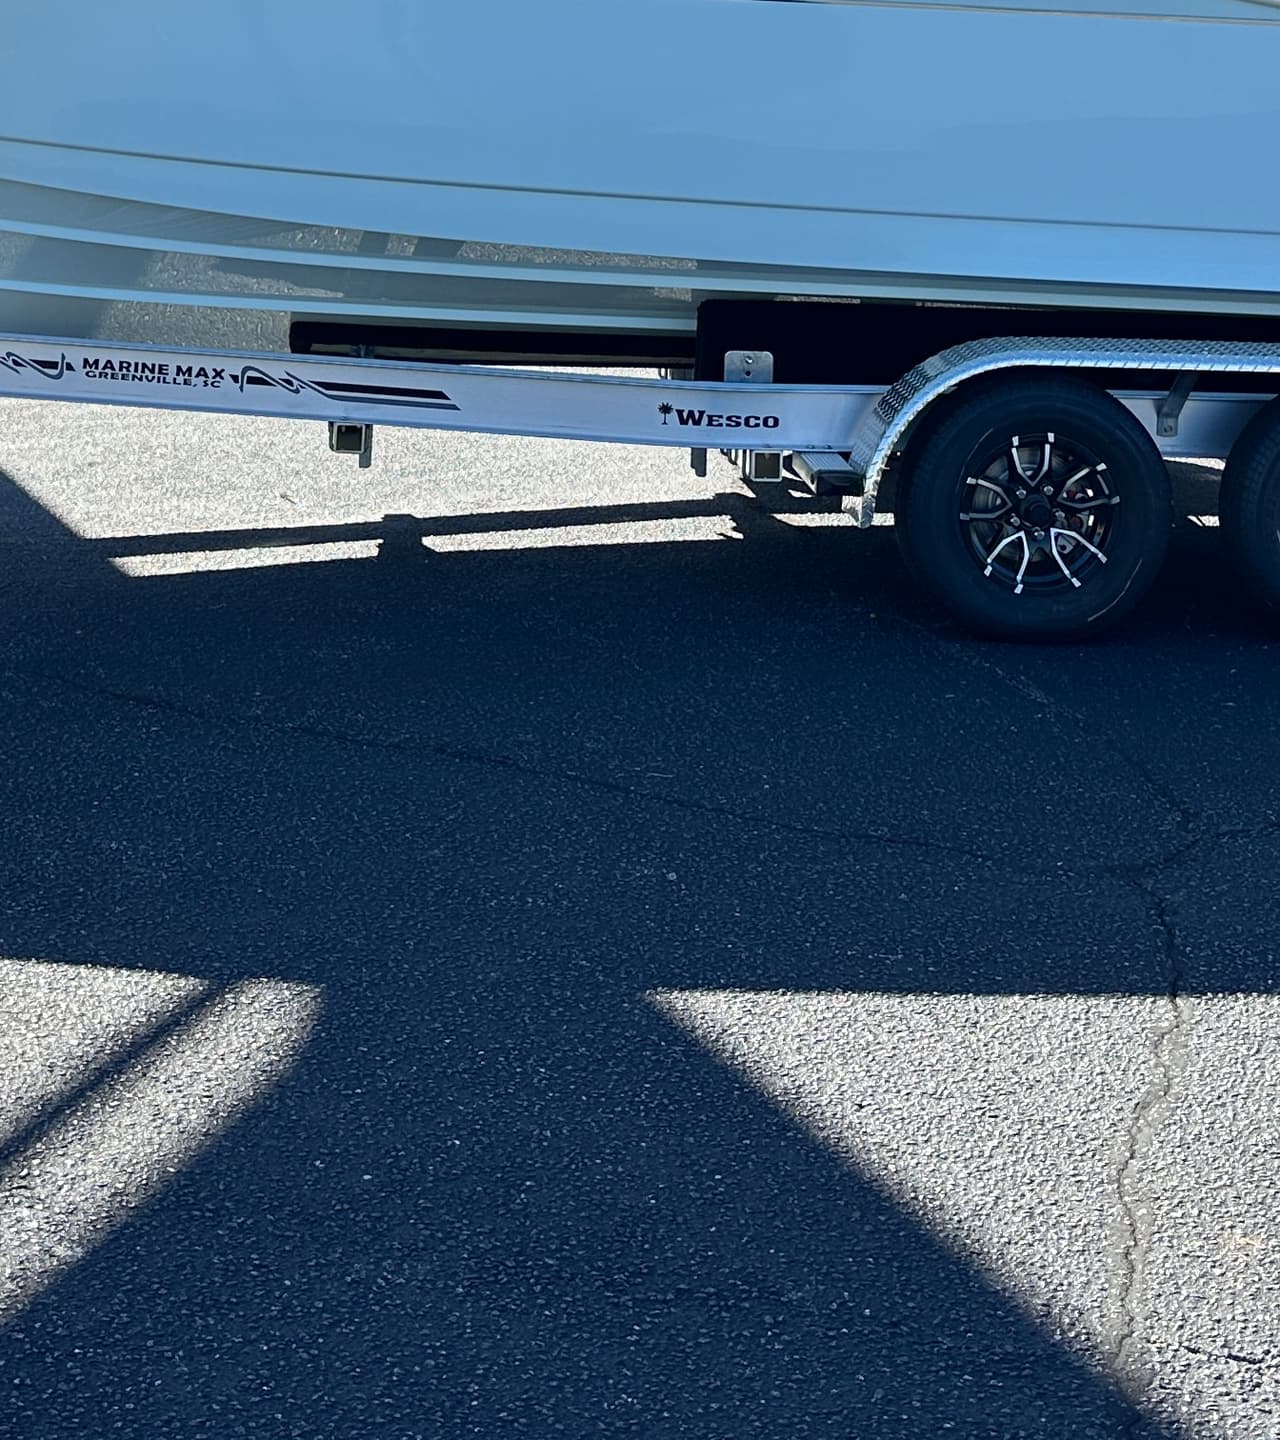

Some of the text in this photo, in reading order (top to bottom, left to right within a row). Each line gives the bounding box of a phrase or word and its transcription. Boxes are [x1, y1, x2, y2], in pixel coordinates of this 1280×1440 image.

[82, 357, 226, 381] MARINE MAX
[85, 370, 222, 388] GREENVILLE, SC
[675, 408, 780, 429] WESCO
